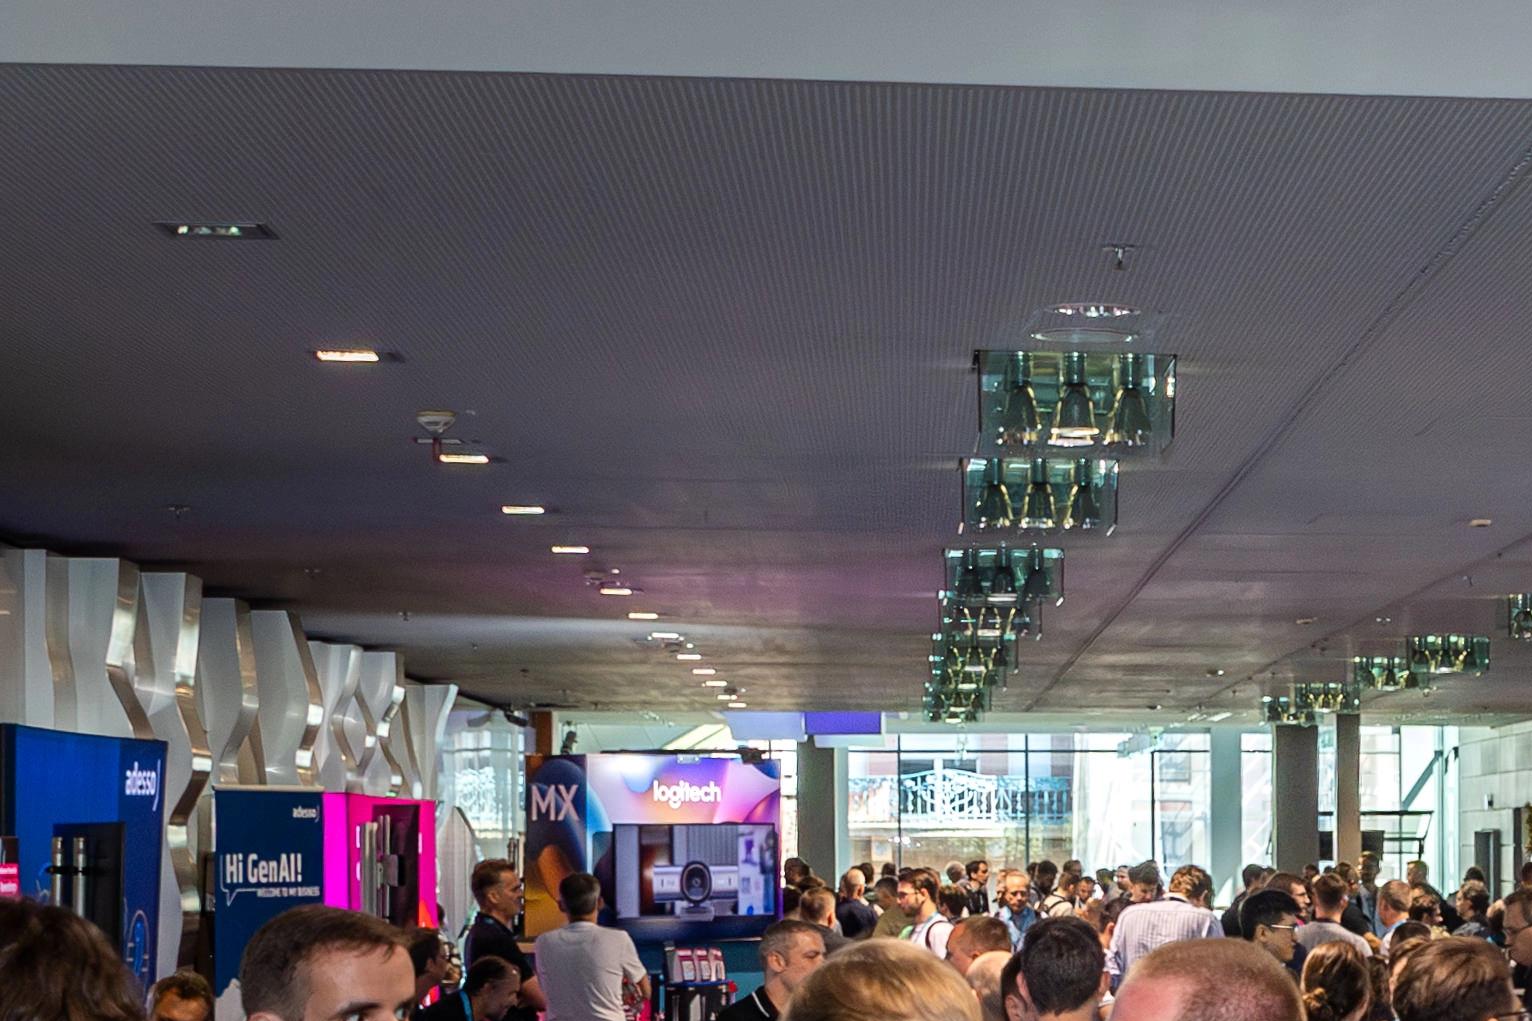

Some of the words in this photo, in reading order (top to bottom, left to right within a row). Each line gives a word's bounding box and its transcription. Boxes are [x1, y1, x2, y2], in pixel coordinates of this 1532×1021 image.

[531, 784, 580, 822] MX
[653, 780, 722, 809] logitech
[225, 853, 244, 884] Hi
[247, 853, 302, 884] GenAI!
